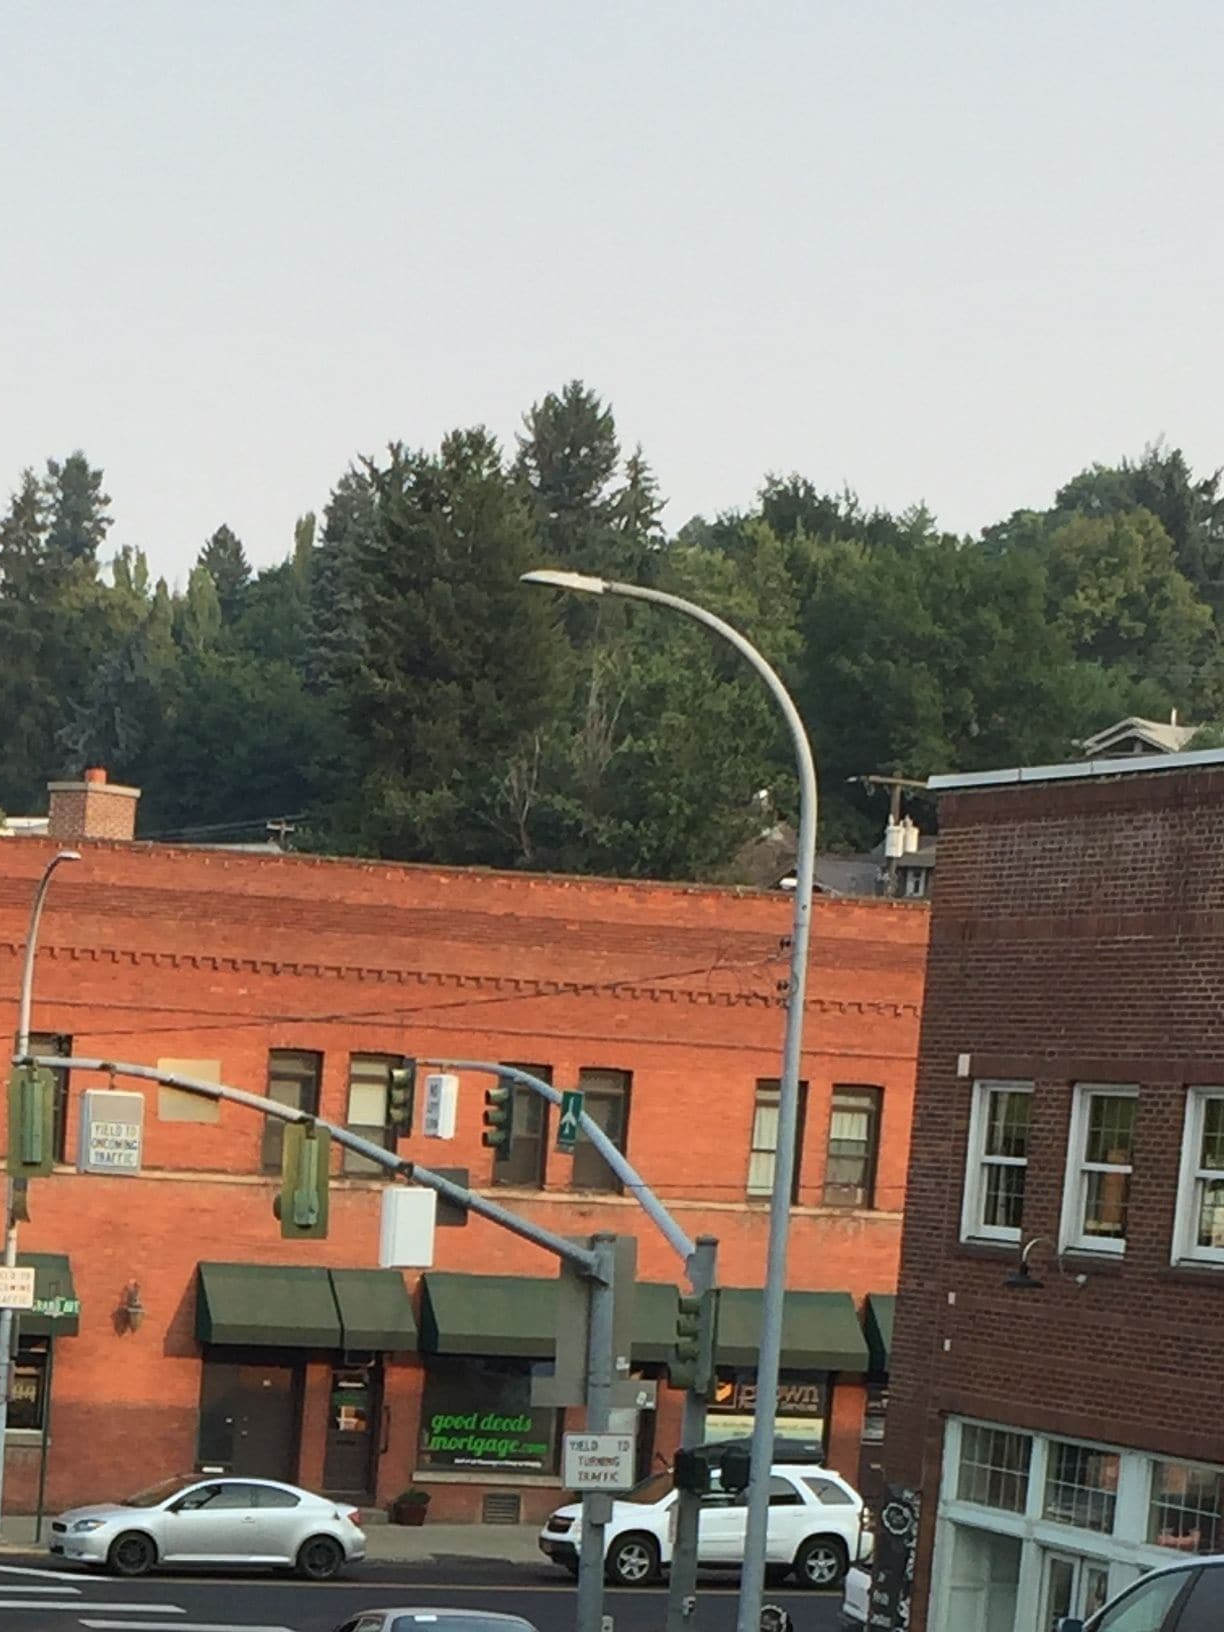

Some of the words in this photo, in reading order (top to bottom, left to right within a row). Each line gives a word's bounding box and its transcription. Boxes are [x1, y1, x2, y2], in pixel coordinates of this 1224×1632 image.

[95, 1124, 121, 1136] YIELD
[126, 1125, 137, 1137] TO
[90, 1138, 137, 1150] ONCOMING
[94, 1151, 135, 1164] TRAFFIC
[431, 1412, 478, 1434] good
[480, 1413, 533, 1432] deeds
[569, 1439, 599, 1452] YIELD
[617, 1440, 630, 1452] TO
[578, 1455, 621, 1467] TURNING
[578, 1470, 620, 1482] TRAFFIC
